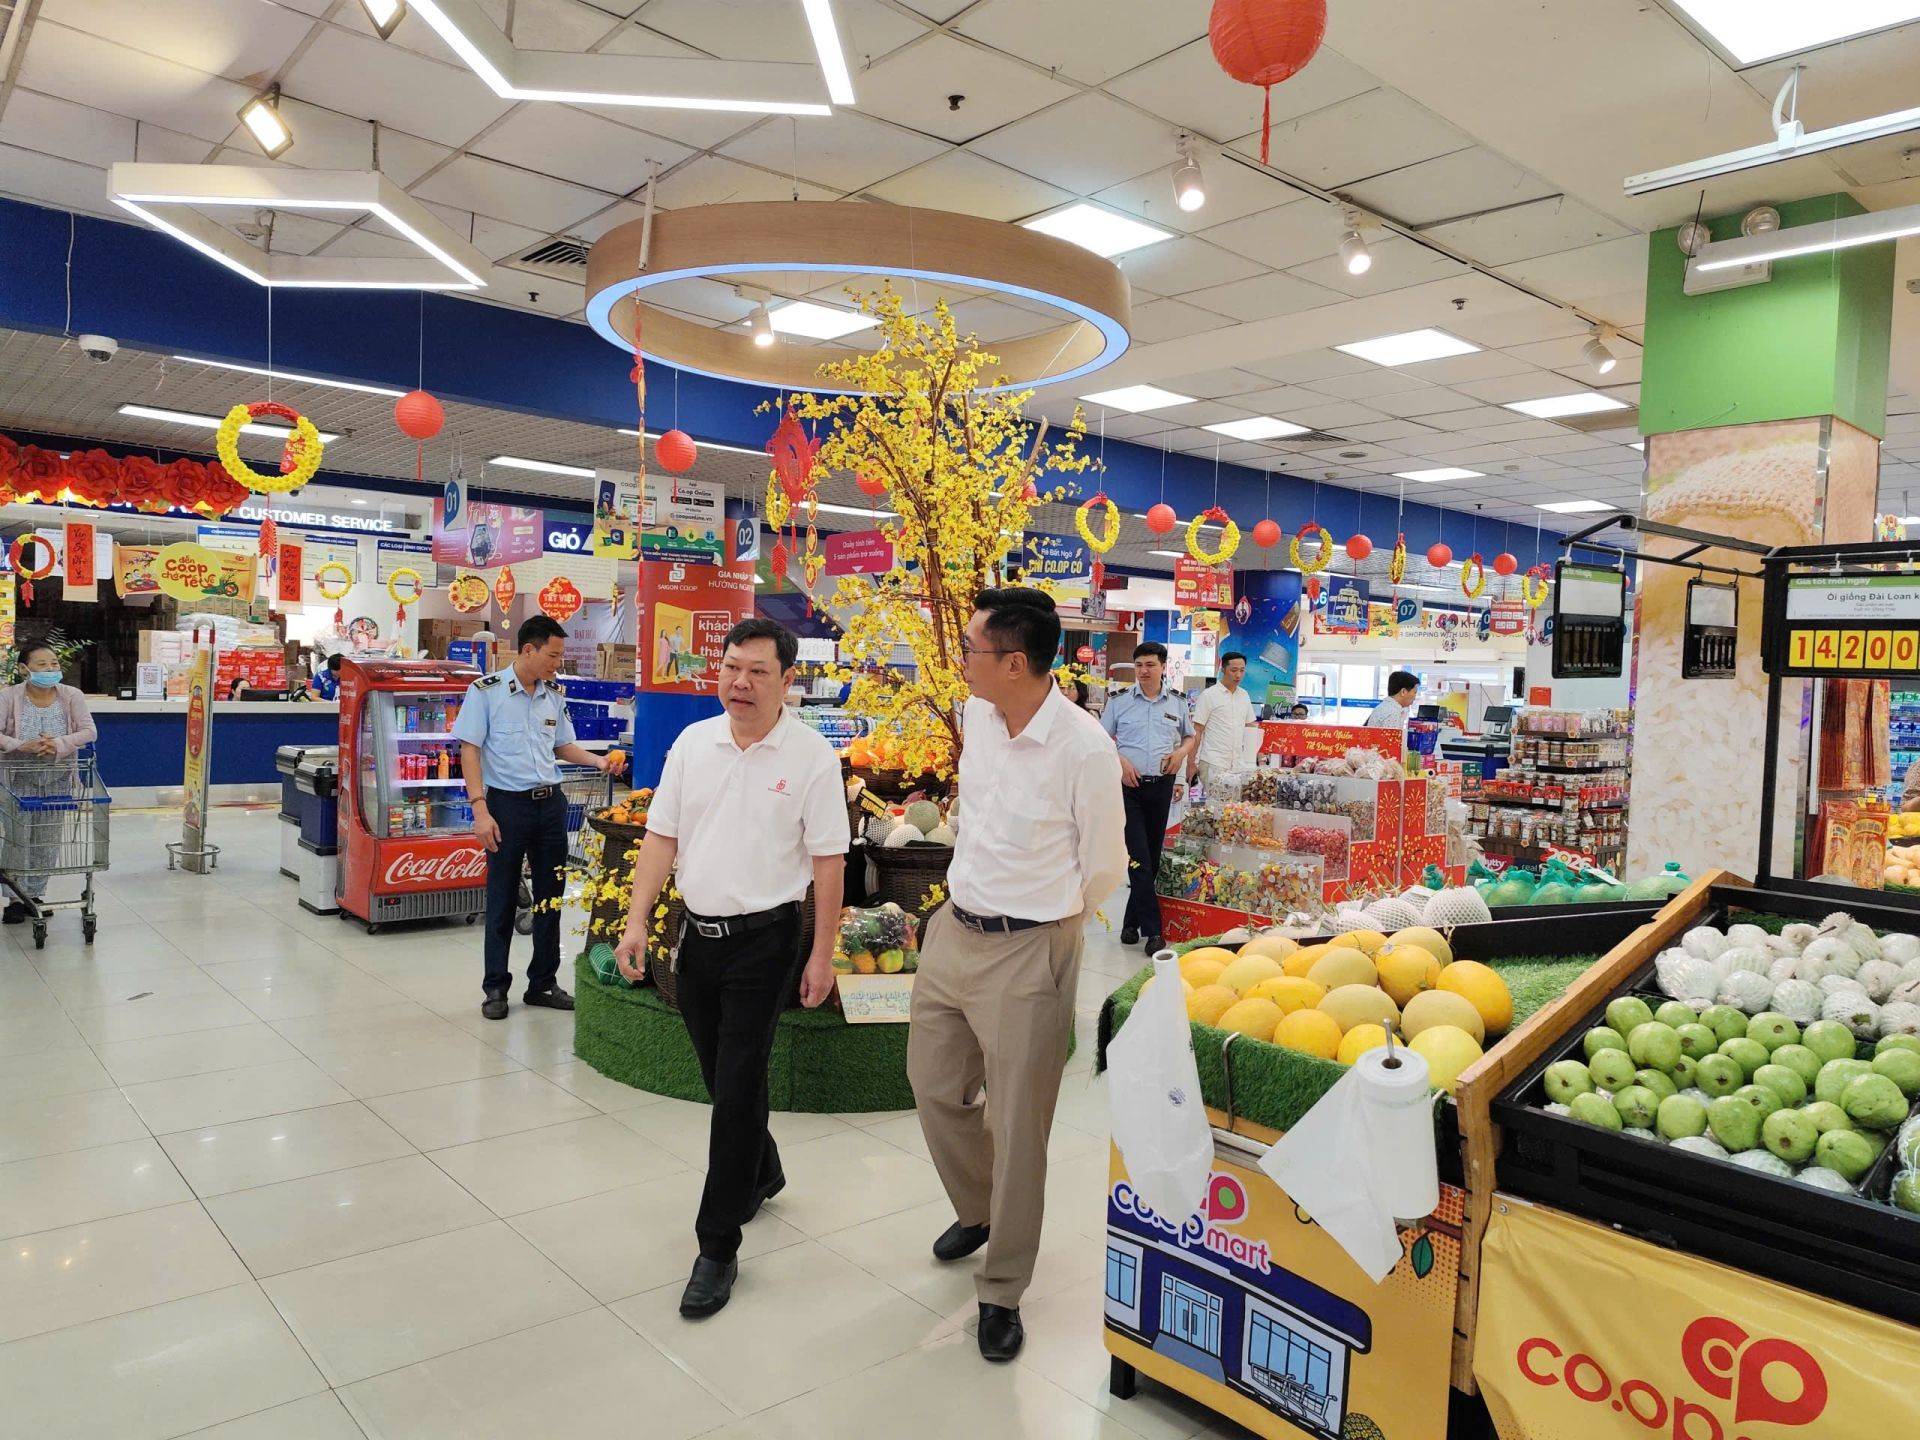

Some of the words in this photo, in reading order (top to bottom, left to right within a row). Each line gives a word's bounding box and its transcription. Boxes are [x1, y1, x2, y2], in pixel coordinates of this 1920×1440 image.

[446, 491, 458, 512] 01
[239, 506, 327, 526] CUSTOMER
[331, 514, 393, 532] SERVICE
[548, 527, 581, 550] GIỎ
[739, 527, 752, 546] 02
[1044, 560, 1070, 574] CO.OP
[1071, 557, 1083, 574] CÓ
[1869, 593, 1885, 601] Đài
[1400, 604, 1415, 616] 07
[1797, 635, 1914, 661] 14.200
